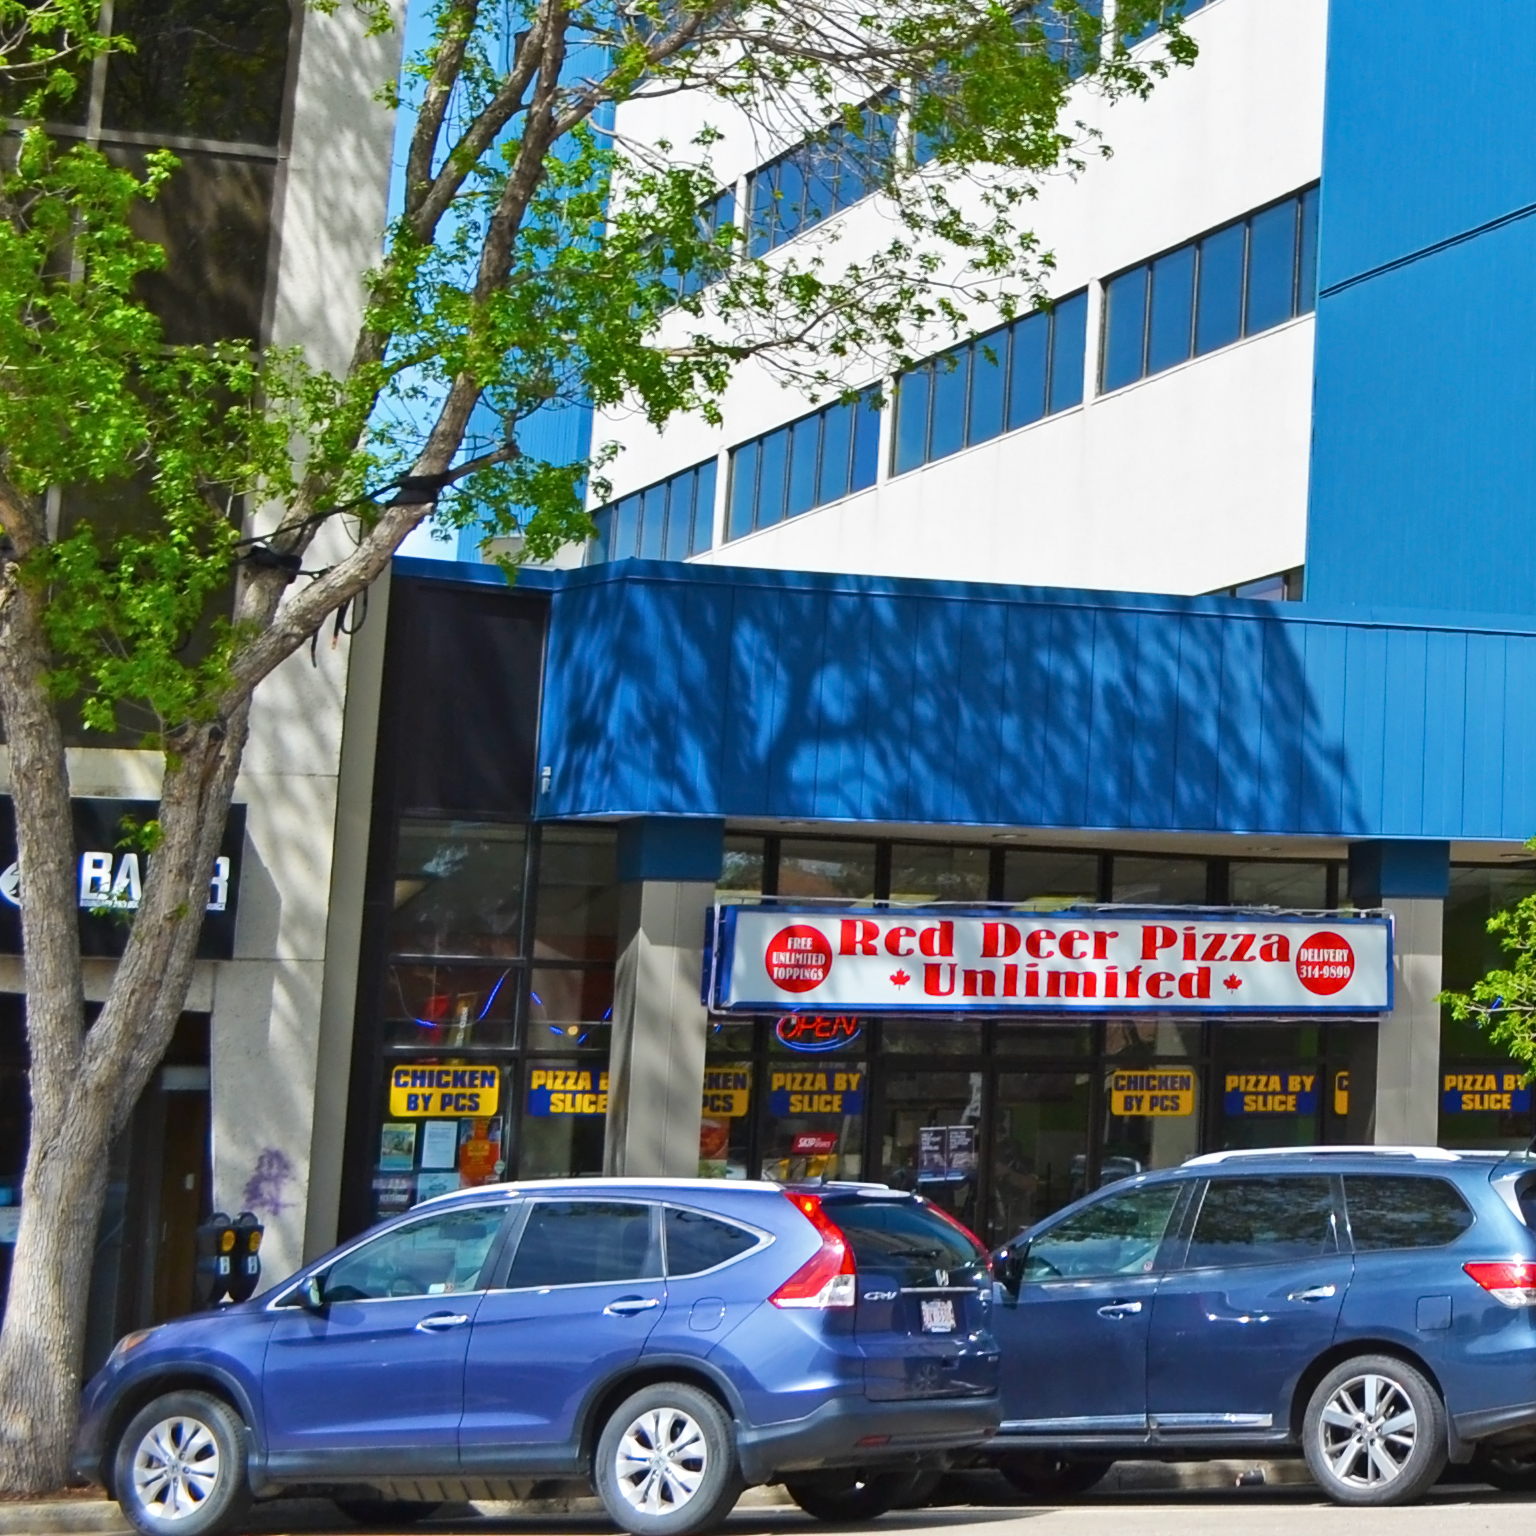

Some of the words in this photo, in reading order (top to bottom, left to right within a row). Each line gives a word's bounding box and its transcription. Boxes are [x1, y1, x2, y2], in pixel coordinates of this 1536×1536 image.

[787, 937, 813, 950] FREE
[838, 919, 954, 957] Red
[980, 922, 1119, 960] Deer
[1140, 925, 1290, 963] Pizza
[772, 952, 826, 965] UNLIMITED
[1301, 948, 1349, 962] DELIVERY
[772, 967, 824, 981] TOPPINGS
[923, 962, 1211, 1000] Unlimited
[1300, 965, 1351, 979] 314-9899
[777, 1011, 859, 1039] OPEN
[394, 1070, 496, 1089] CHICKEN
[531, 1070, 592, 1091] PIZZA
[599, 1070, 609, 1090] B
[771, 1072, 828, 1092] PIZZA
[834, 1073, 862, 1091] BY
[1113, 1075, 1191, 1092] CHICKEN
[1225, 1075, 1281, 1092] PIZZA
[1288, 1075, 1315, 1092] BY
[1444, 1074, 1497, 1091] PIZZA
[1503, 1074, 1526, 1091] BY
[407, 1093, 432, 1112] BY
[440, 1093, 480, 1112] PCS
[550, 1093, 608, 1114] SLICE
[789, 1094, 843, 1113] SLICE
[1124, 1095, 1146, 1112] BY
[1150, 1095, 1180, 1112] PCS
[1243, 1094, 1297, 1112] SLICE
[1461, 1093, 1512, 1111] SLICE
